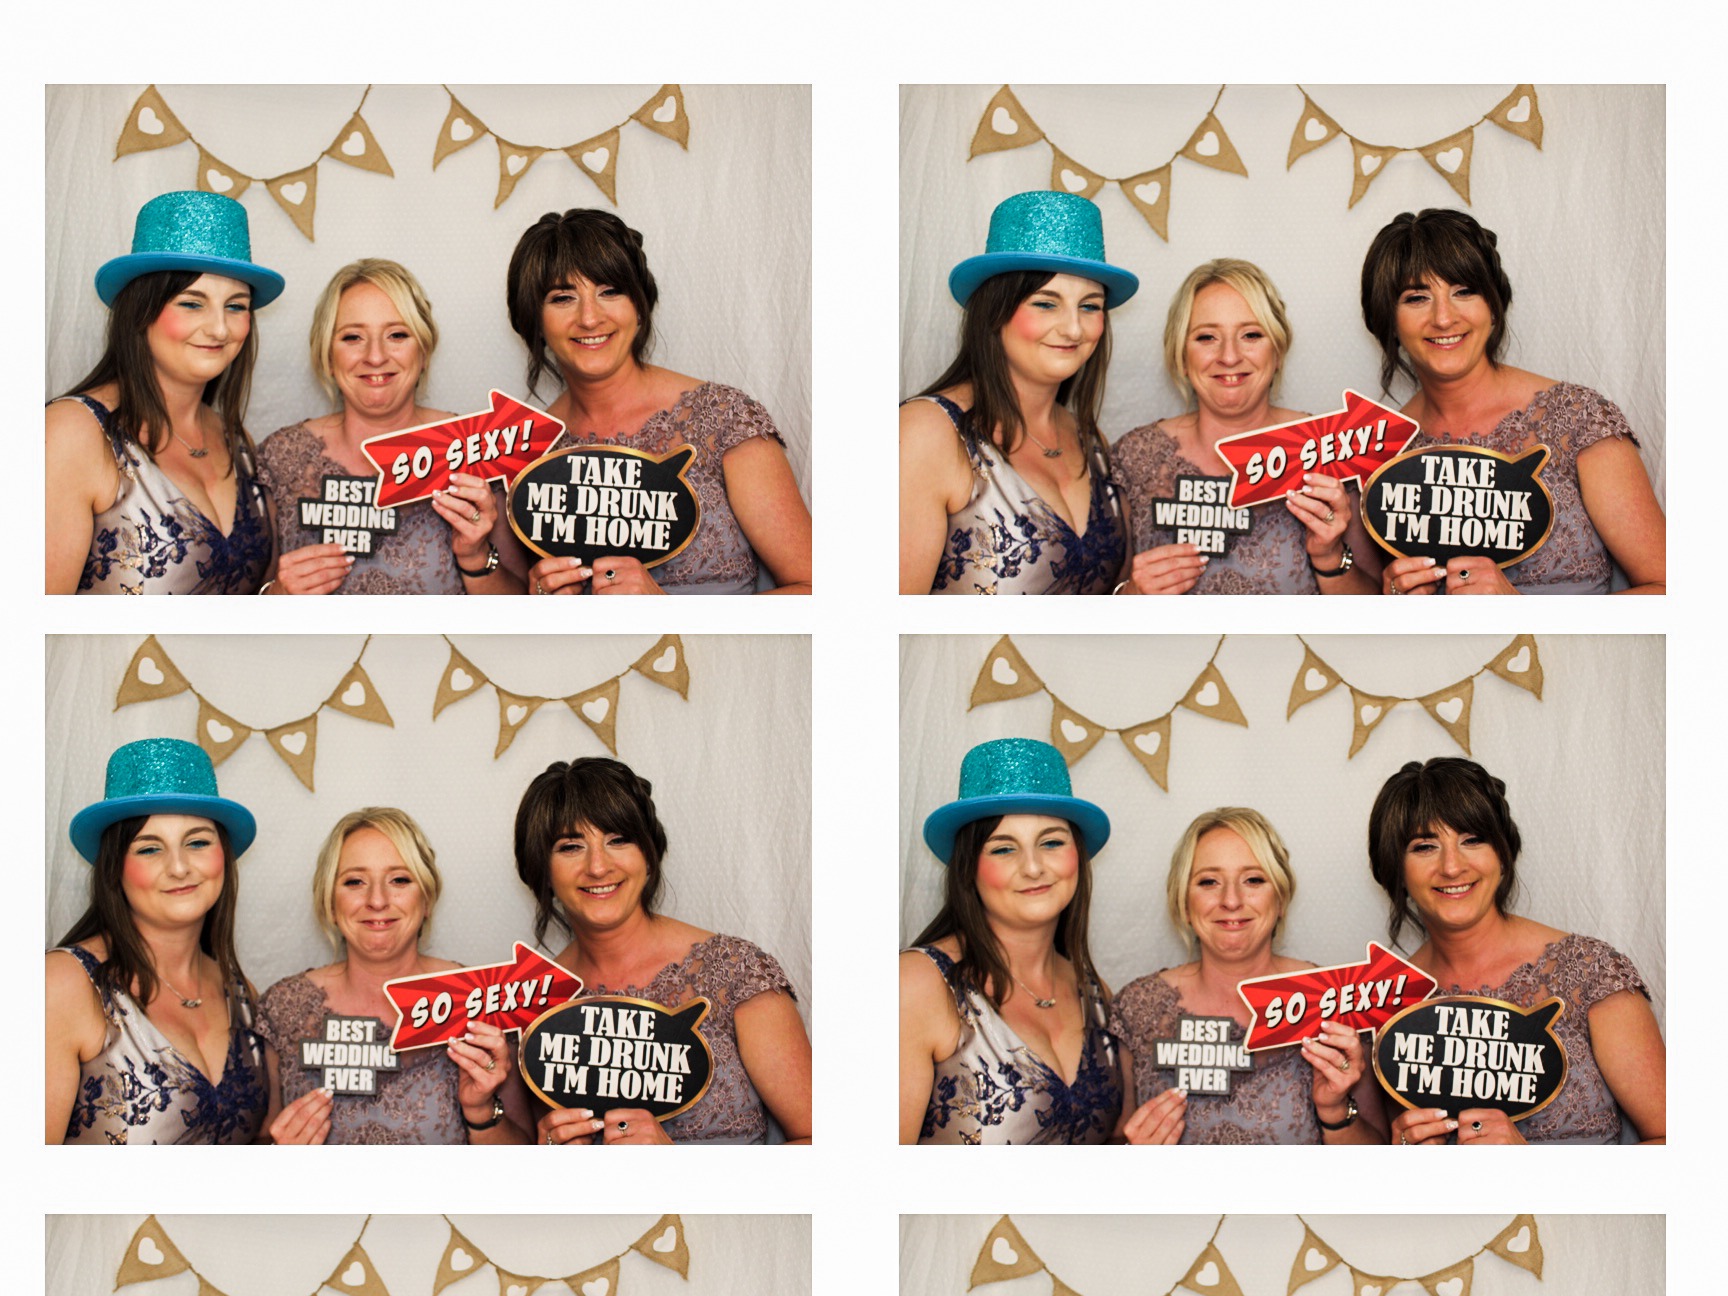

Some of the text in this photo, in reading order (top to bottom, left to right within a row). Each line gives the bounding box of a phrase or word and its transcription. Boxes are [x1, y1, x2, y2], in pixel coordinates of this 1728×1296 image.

[391, 419, 533, 484] SO SEXY!
[1245, 419, 1387, 484] SO SEXY!
[567, 455, 642, 488] TAKE
[1421, 455, 1496, 488] TAKE
[325, 480, 375, 503] BEST
[526, 483, 678, 521] ME DRUNK
[1179, 480, 1229, 503] BEST
[1380, 483, 1532, 521] ME DRUNK
[302, 503, 395, 529] WEDDING
[531, 512, 671, 550] I'M HOME
[1156, 503, 1249, 529] WEDDING
[1385, 512, 1525, 550] I'M HOME
[411, 974, 553, 1028] SO SEXY!
[1265, 974, 1407, 1028] SO SEXY!
[326, 1020, 376, 1042] BEST
[580, 1005, 655, 1040] TAKE
[1180, 1020, 1230, 1042] BEST
[1434, 1005, 1509, 1040] TAKE
[303, 1043, 396, 1067] WEDDING
[539, 1032, 692, 1074] ME DRUNK
[1157, 1043, 1250, 1067] WEDDING
[1393, 1032, 1546, 1074] ME DRUNK
[325, 1068, 373, 1091] EVER
[542, 1062, 683, 1104] I'M HOME
[1179, 1068, 1227, 1091] EVER
[1396, 1062, 1537, 1104] I'M HOME
